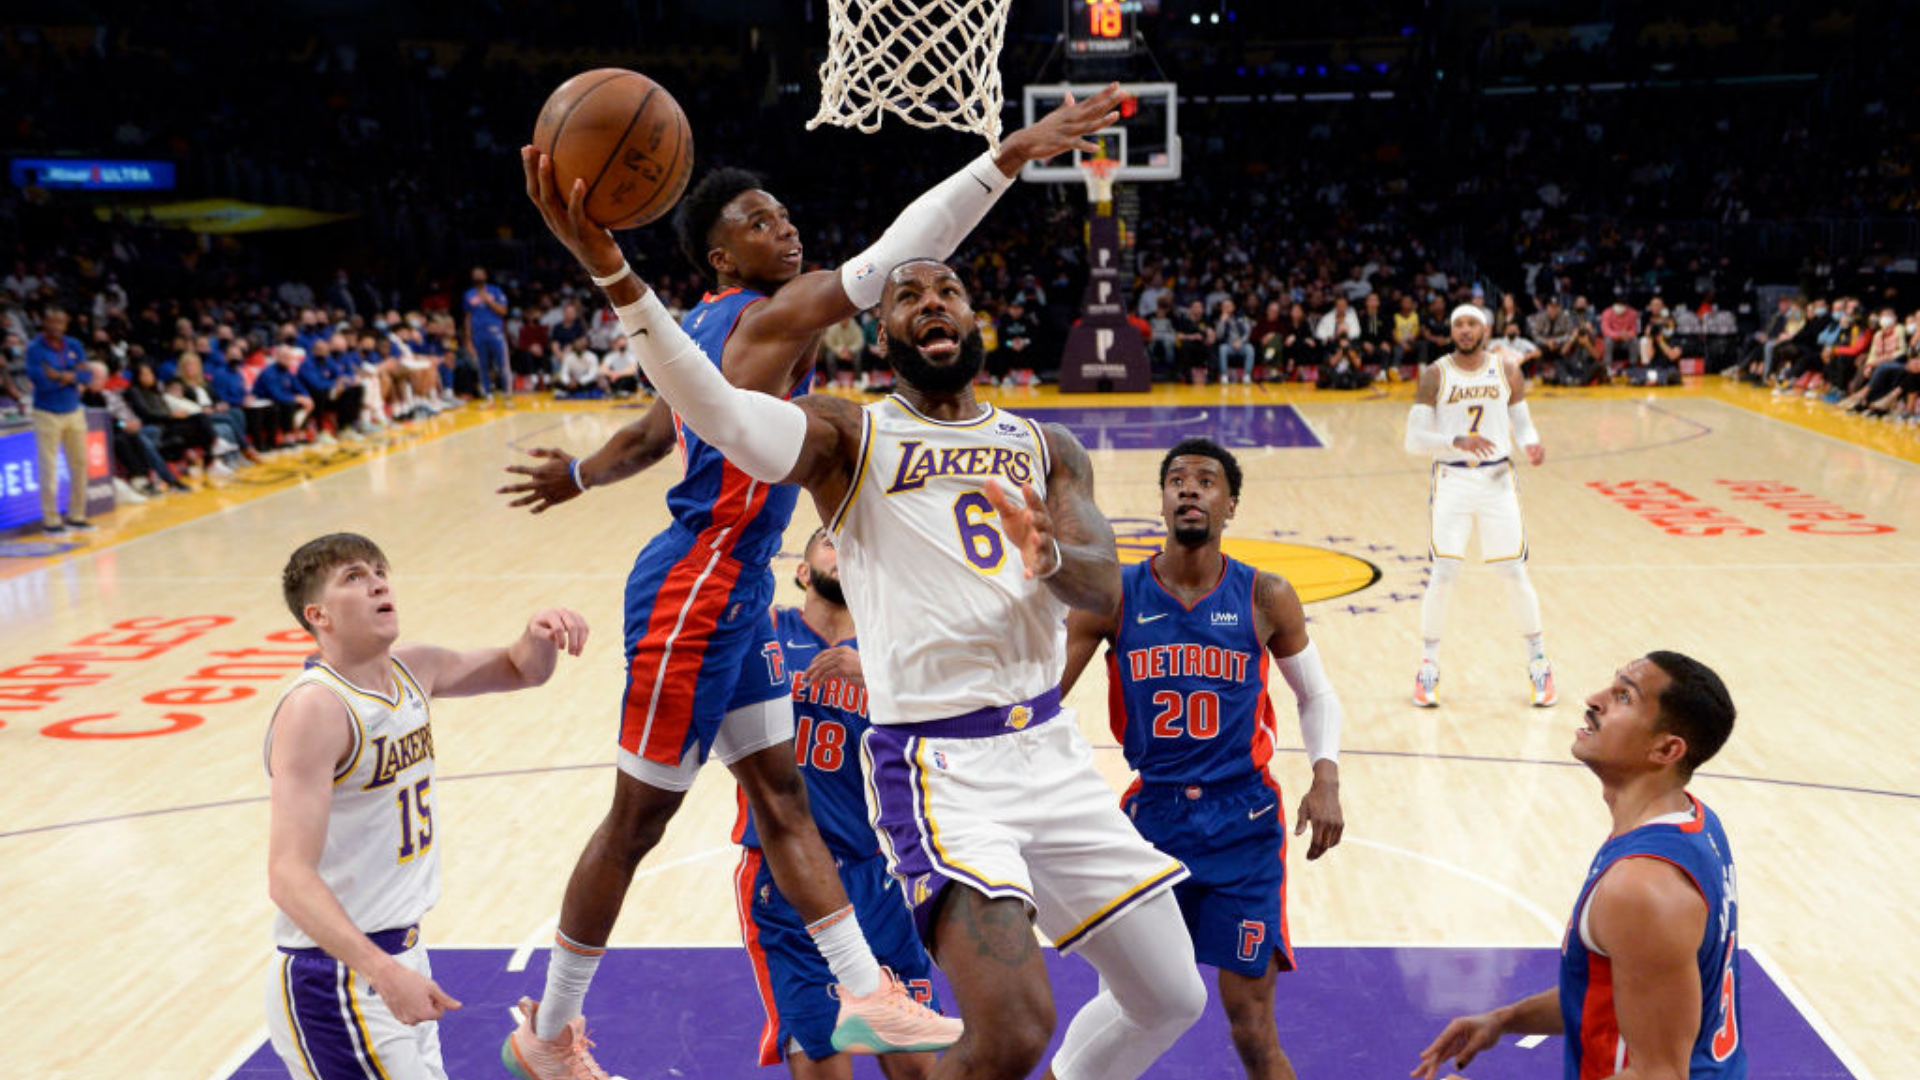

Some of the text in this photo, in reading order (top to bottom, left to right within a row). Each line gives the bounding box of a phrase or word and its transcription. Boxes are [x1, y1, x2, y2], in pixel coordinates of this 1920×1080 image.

[1090, 2, 1122, 37] 18
[1447, 383, 1500, 404] LAKERS
[1467, 404, 1484, 437] 7
[885, 439, 1034, 495] LAKERS
[952, 490, 1007, 575] 6
[1210, 611, 1238, 623] UWM
[1127, 643, 1251, 683] DETROIT
[1152, 689, 1220, 740] 20
[795, 715, 847, 772] 18
[397, 775, 434, 867] 15
